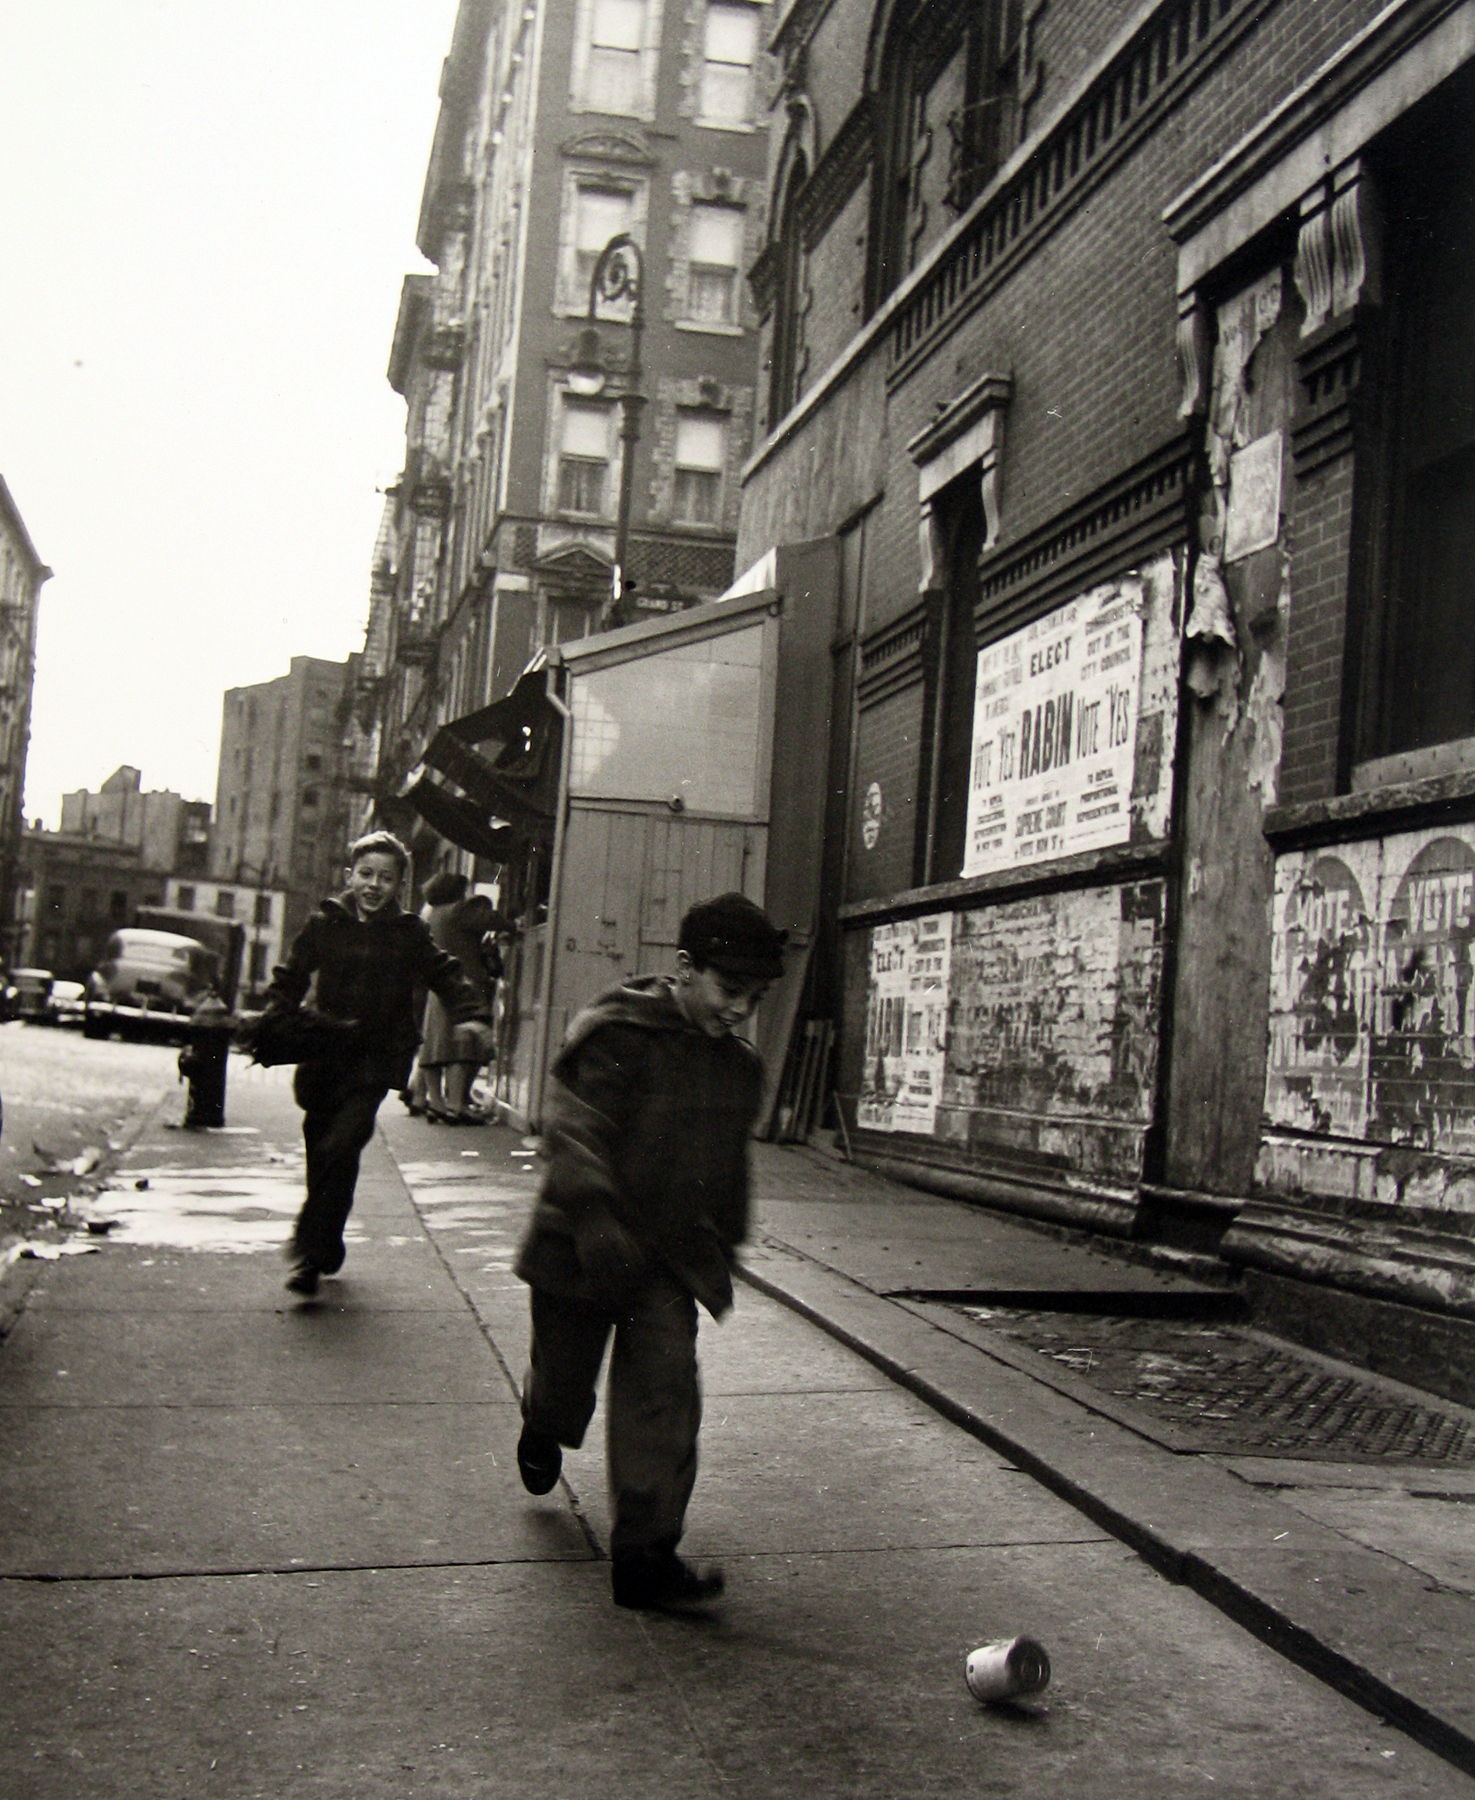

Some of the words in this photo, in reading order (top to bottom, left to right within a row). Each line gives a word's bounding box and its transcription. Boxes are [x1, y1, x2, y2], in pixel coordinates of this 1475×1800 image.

[1030, 635, 1071, 678] ELECT
[1020, 691, 1073, 780] RABIN
[1077, 698, 1101, 759] VOTE
[1296, 888, 1351, 942] VOTE
[1409, 873, 1474, 933] VOTE
